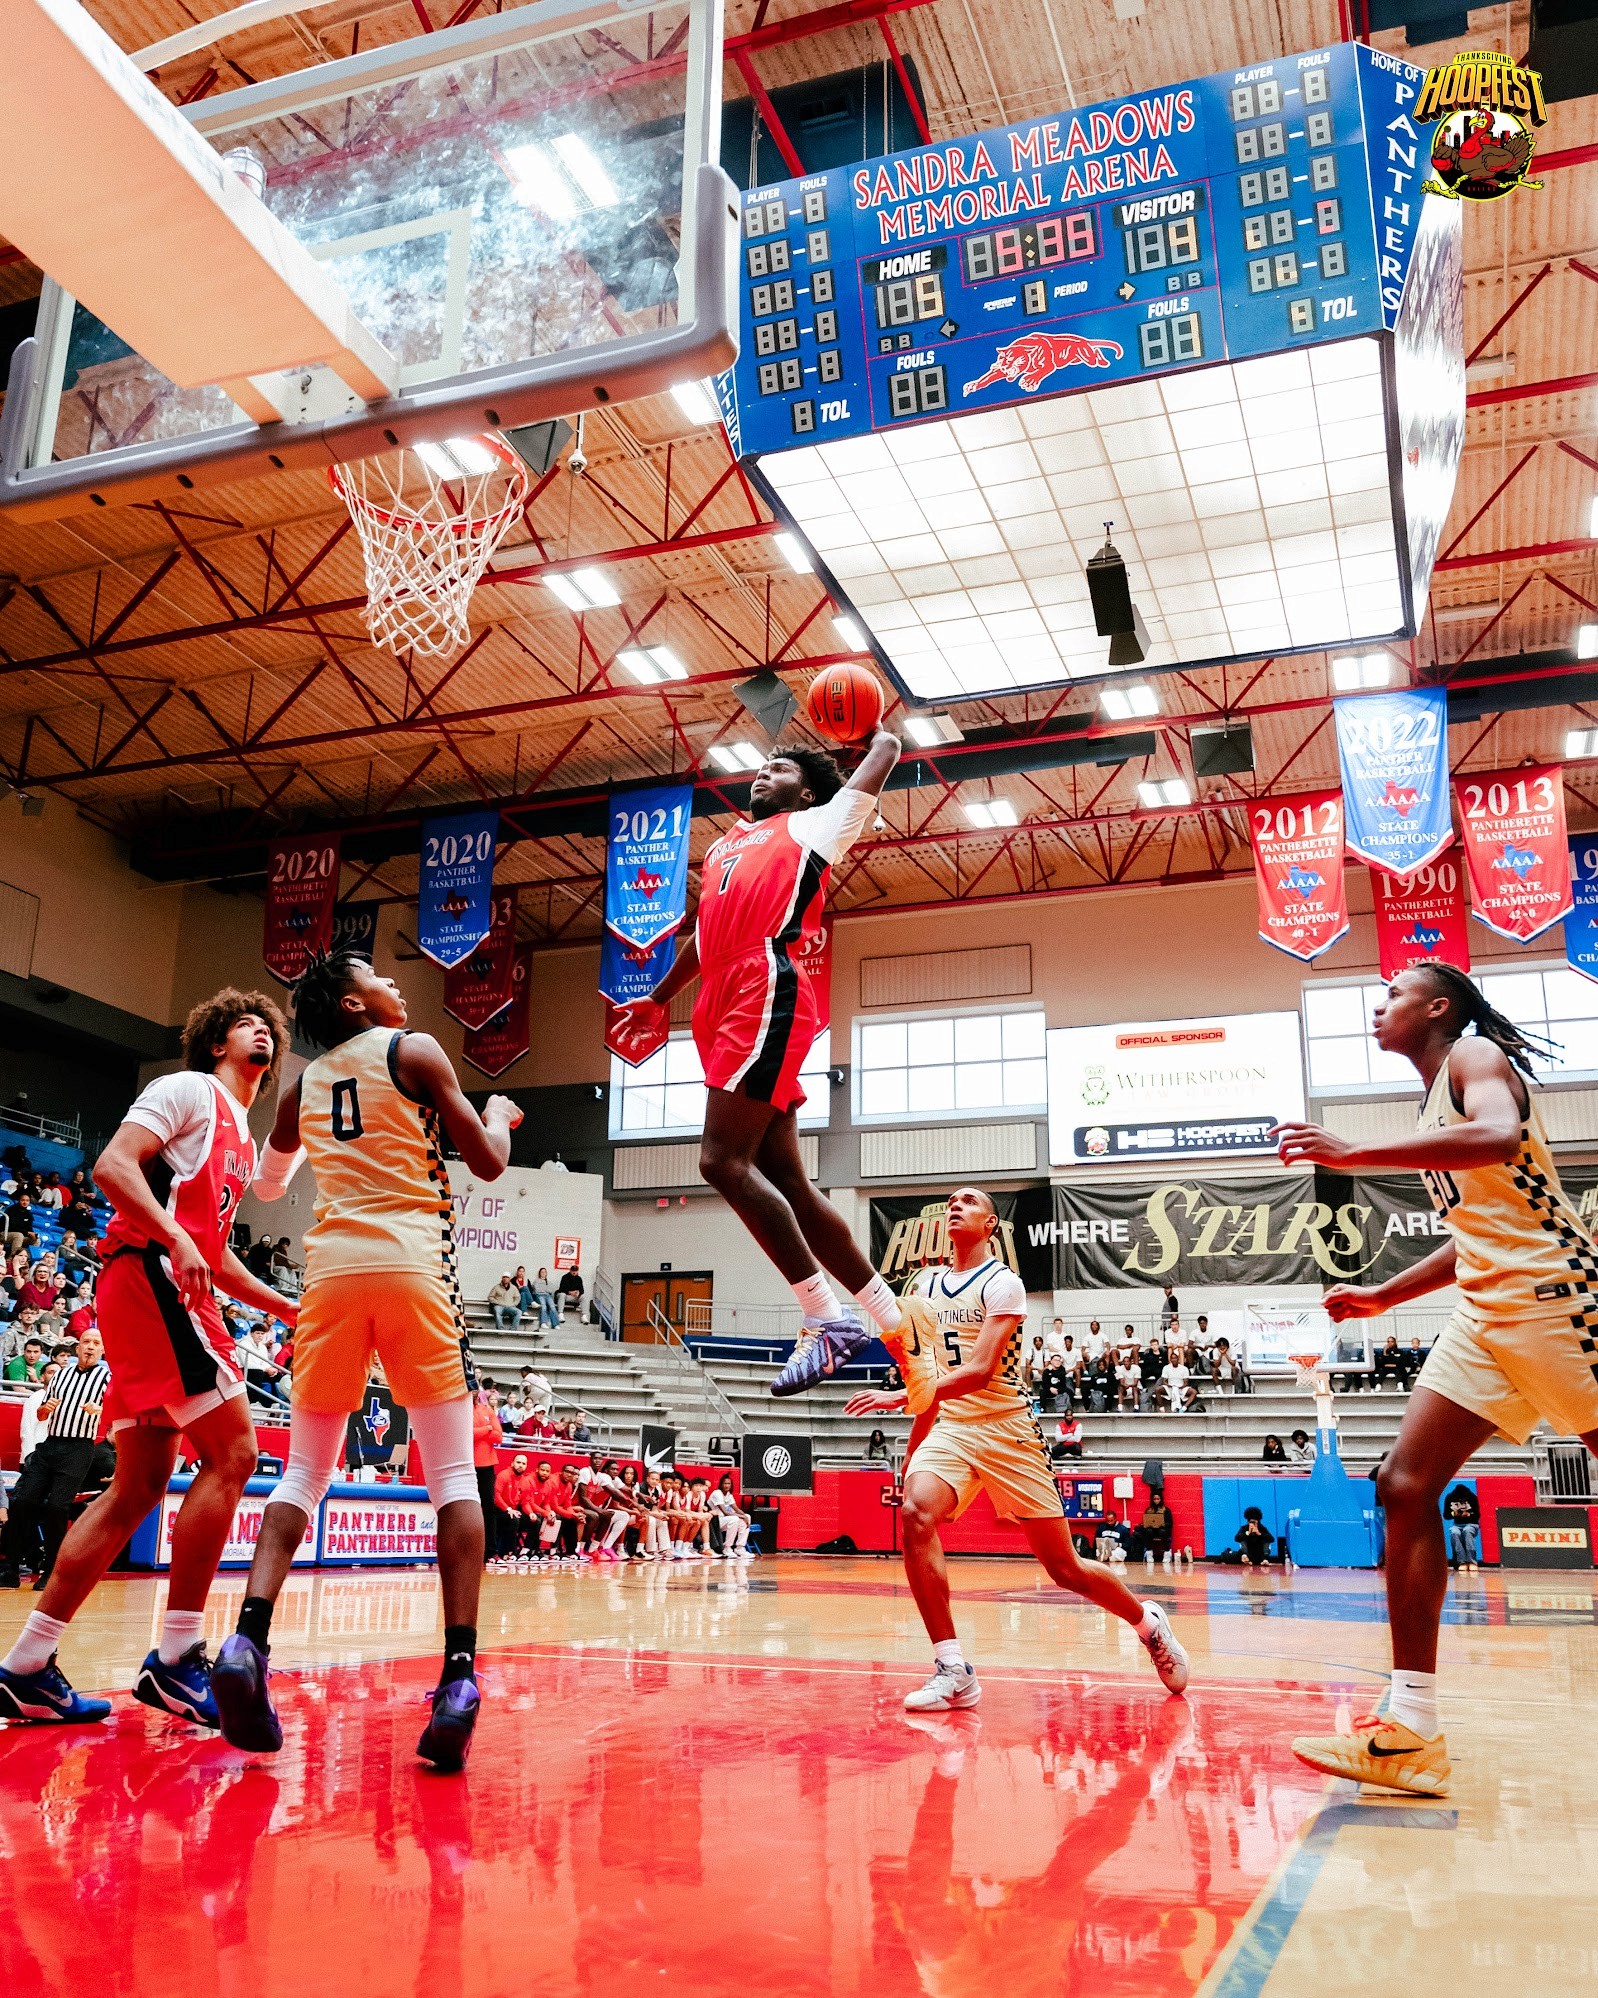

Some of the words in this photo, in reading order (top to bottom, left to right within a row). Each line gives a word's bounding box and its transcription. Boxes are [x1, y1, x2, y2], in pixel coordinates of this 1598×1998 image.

[1235, 66, 1273, 84] PLAYER
[1297, 52, 1330, 70] FOULS
[1371, 52, 1402, 76] HOME
[1404, 66, 1418, 83] OF
[854, 140, 998, 210] SANDRA
[1008, 90, 1196, 172] MEADOWS
[747, 188, 780, 204] PLAYER
[799, 175, 828, 191] FOULS
[877, 173, 1051, 244] MEMORIAL
[1062, 144, 1179, 202] ARENA
[1380, 80, 1418, 312] PANTHERS
[1121, 190, 1196, 226] VISITOR
[879, 250, 932, 281] HOME
[1054, 281, 1088, 299] PERIOD
[1148, 297, 1189, 319] FOULS
[1321, 296, 1357, 322] TOL
[897, 350, 935, 371] FOULS
[820, 400, 850, 423] TOL
[1344, 711, 1439, 754] 2022
[1366, 751, 1423, 766] PANTHER
[1356, 763, 1435, 779] BASKETBALL
[1364, 791, 1431, 807] AAAAAA
[1464, 776, 1555, 818] 2013
[613, 805, 683, 842] 2021
[1255, 801, 1339, 840] 2012
[1378, 820, 1419, 832] STATE
[1471, 814, 1554, 831] PANTHERETTE
[1360, 833, 1438, 847] CHAMPIONS
[1476, 826, 1552, 843] BASKETBALL
[425, 831, 491, 867] 2020
[625, 842, 669, 854] PANTHER
[1260, 836, 1338, 853] PANTHERETTE
[617, 851, 676, 866] BASKETBALL
[1264, 848, 1336, 864] BASKETBALL
[1490, 855, 1543, 869] AAAAA
[272, 848, 335, 882] 2020
[437, 865, 476, 877] PANTHER
[428, 875, 482, 889] BASKETBALL
[718, 853, 742, 896] 7
[1277, 876, 1326, 889] AAAAA
[1379, 863, 1456, 898] 1990
[620, 877, 671, 890] AAAAAA
[1500, 881, 1542, 894] STATE
[627, 902, 661, 913] STATE
[1284, 902, 1324, 914] STATE
[1384, 897, 1455, 911] PANTHERETTE
[1482, 892, 1561, 909] CHAMPIONS
[613, 911, 675, 926] CHAMPIONS
[1268, 912, 1339, 927] CHAMPIONS
[1388, 909, 1453, 922] BASKETBALL
[440, 924, 464, 934] STATE
[1400, 932, 1446, 944] AAAAA
[1406, 956, 1441, 967] STATE
[622, 973, 651, 982] STATE
[610, 983, 657, 994] CHAMPIO
[1120, 1036, 1167, 1046] OFFICIAL
[1171, 1032, 1223, 1042] SPONSOR
[331, 1077, 364, 1142] 0
[1177, 1123, 1270, 1139] HOOPFEST
[450, 1194, 470, 1215] TY
[482, 1198, 505, 1218] OF
[453, 1228, 517, 1251] MPIONS
[1028, 1219, 1130, 1247] WHERE
[1121, 1185, 1388, 1278] STARS
[937, 1308, 984, 1324] NTINELS
[943, 1331, 961, 1366] 5
[328, 1511, 417, 1532] PANTHERS
[420, 1517, 435, 1530] and
[327, 1534, 437, 1553] PANTHERETTES
[1508, 1532, 1581, 1543] PANINI
[223, 1548, 247, 1556] MORIAL
